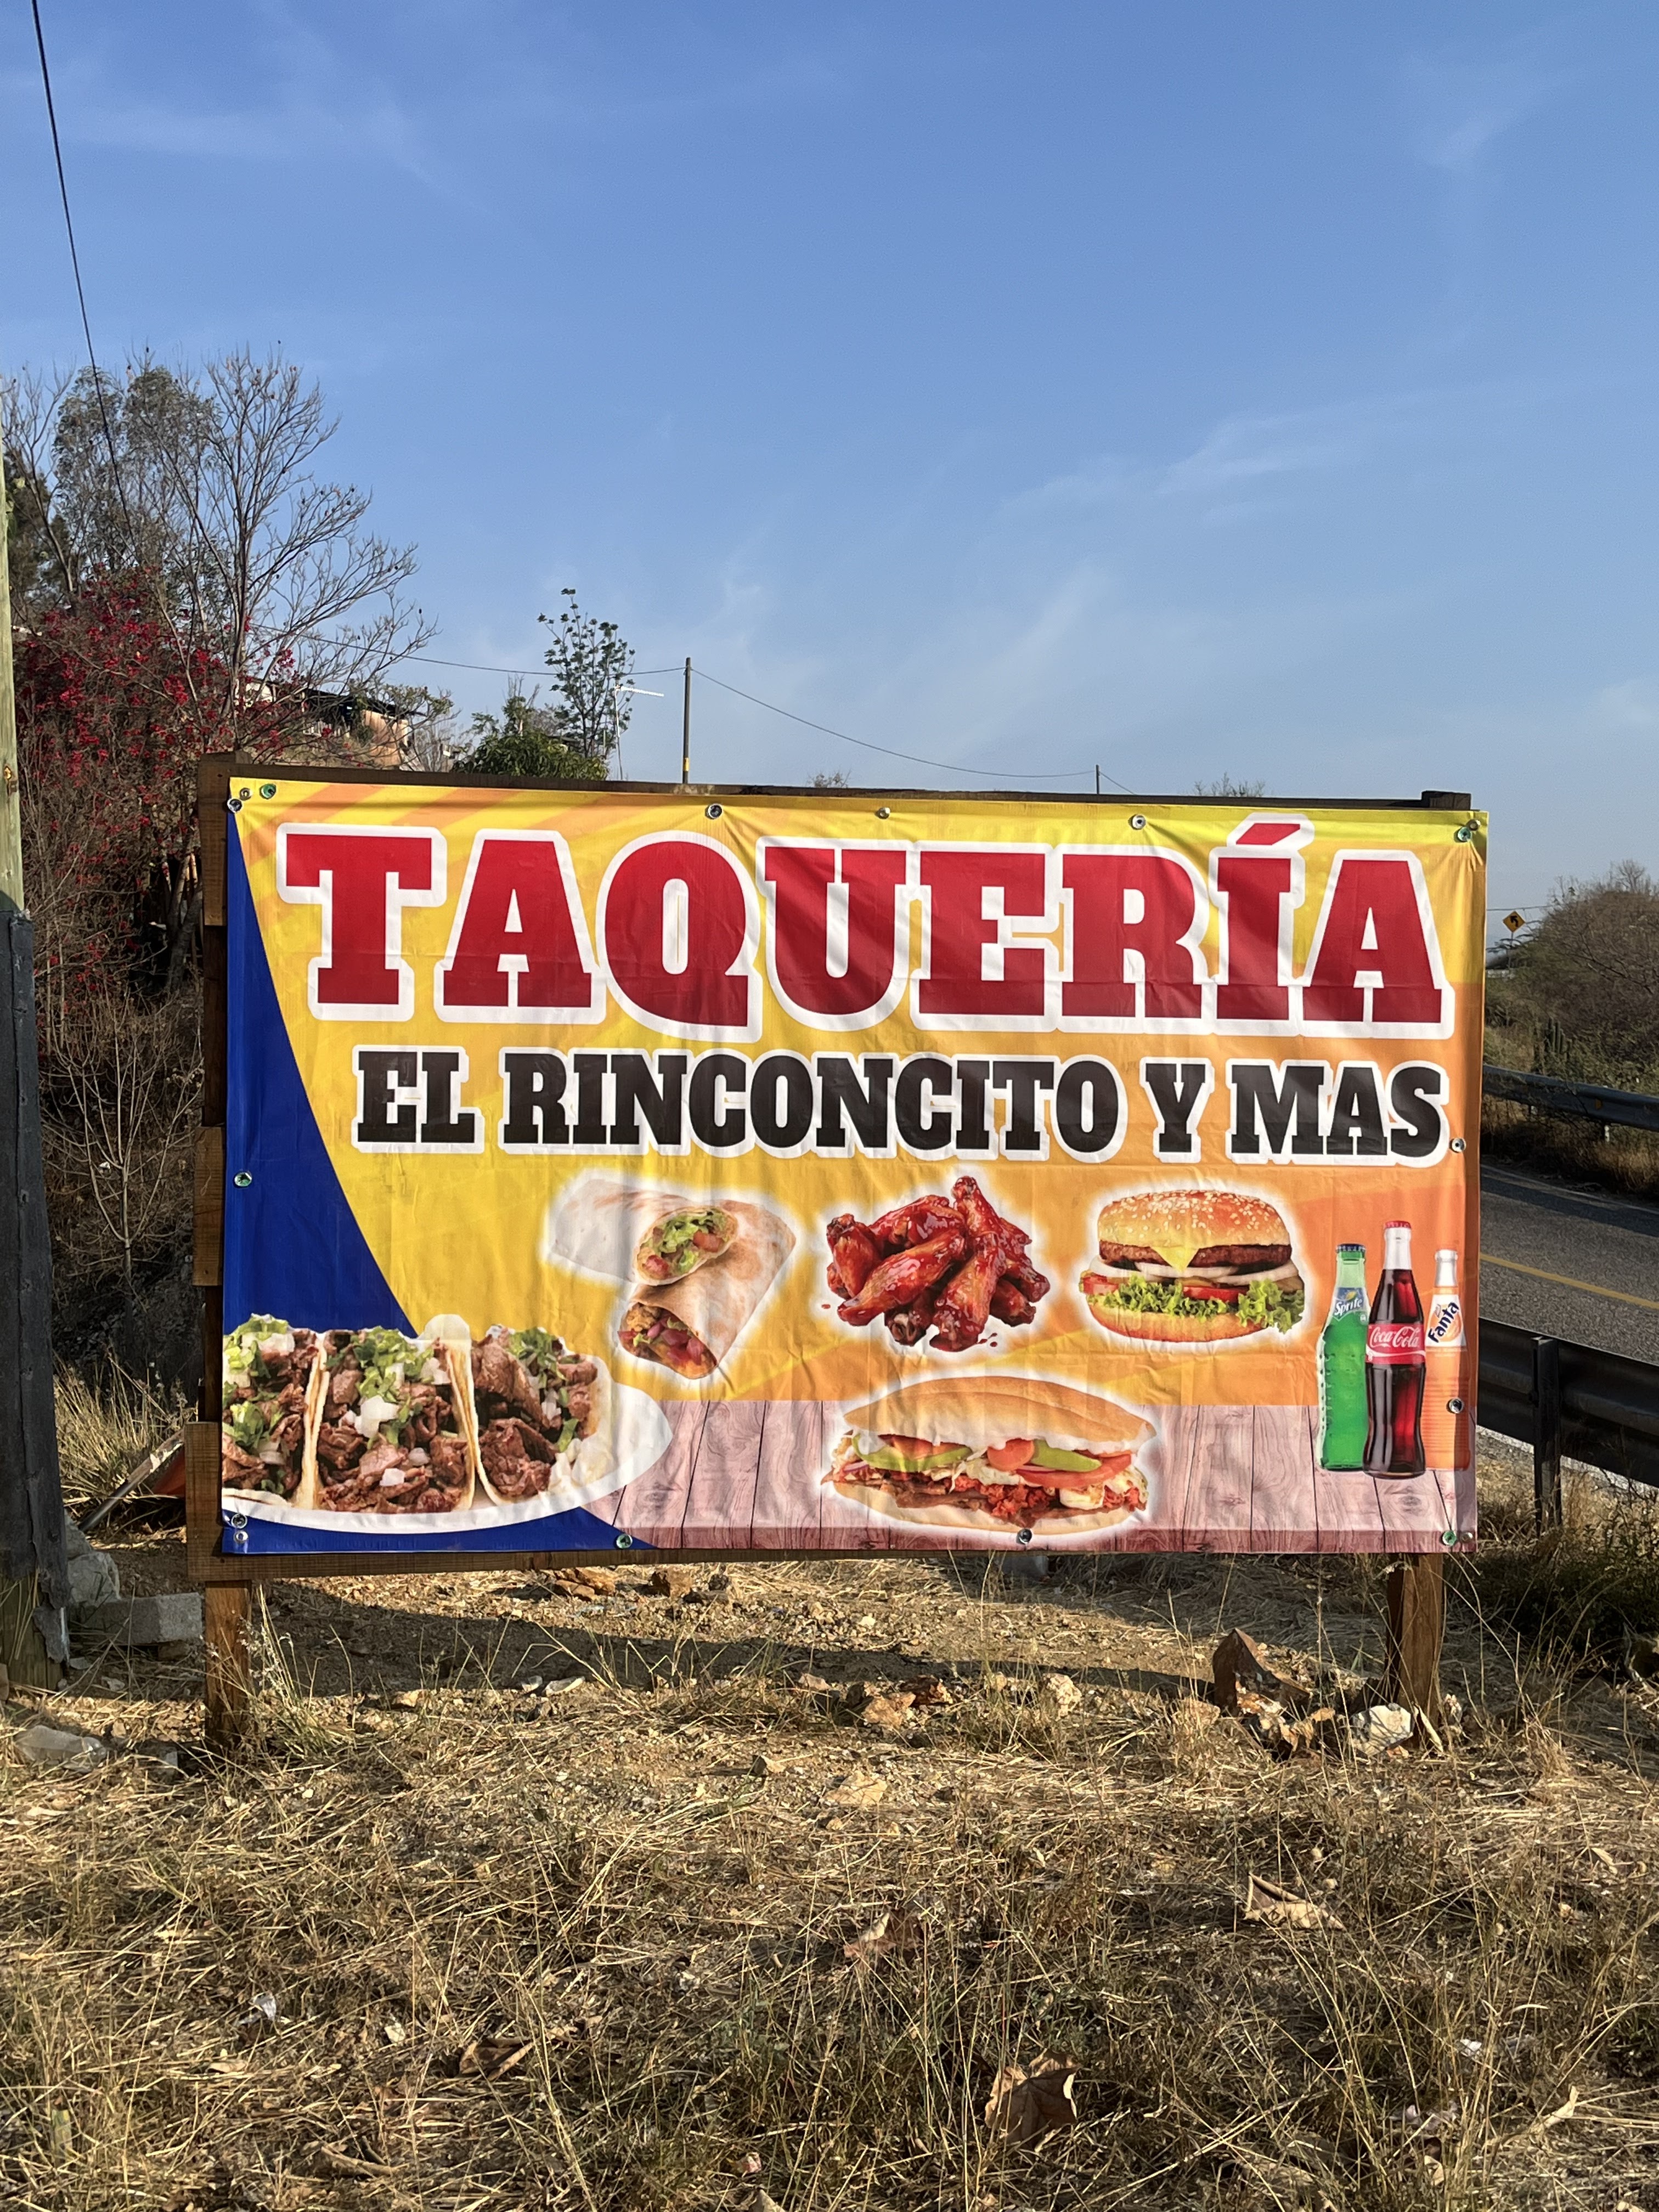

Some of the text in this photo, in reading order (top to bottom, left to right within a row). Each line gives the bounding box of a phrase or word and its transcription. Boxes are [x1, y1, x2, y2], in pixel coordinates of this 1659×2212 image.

[285, 823, 1443, 1028] TAQUERÍA
[358, 1051, 1441, 1158] EL RINCONCITO Y MAS
[1334, 1296, 1363, 1317] Sprite
[1427, 1301, 1460, 1344] Fanta
